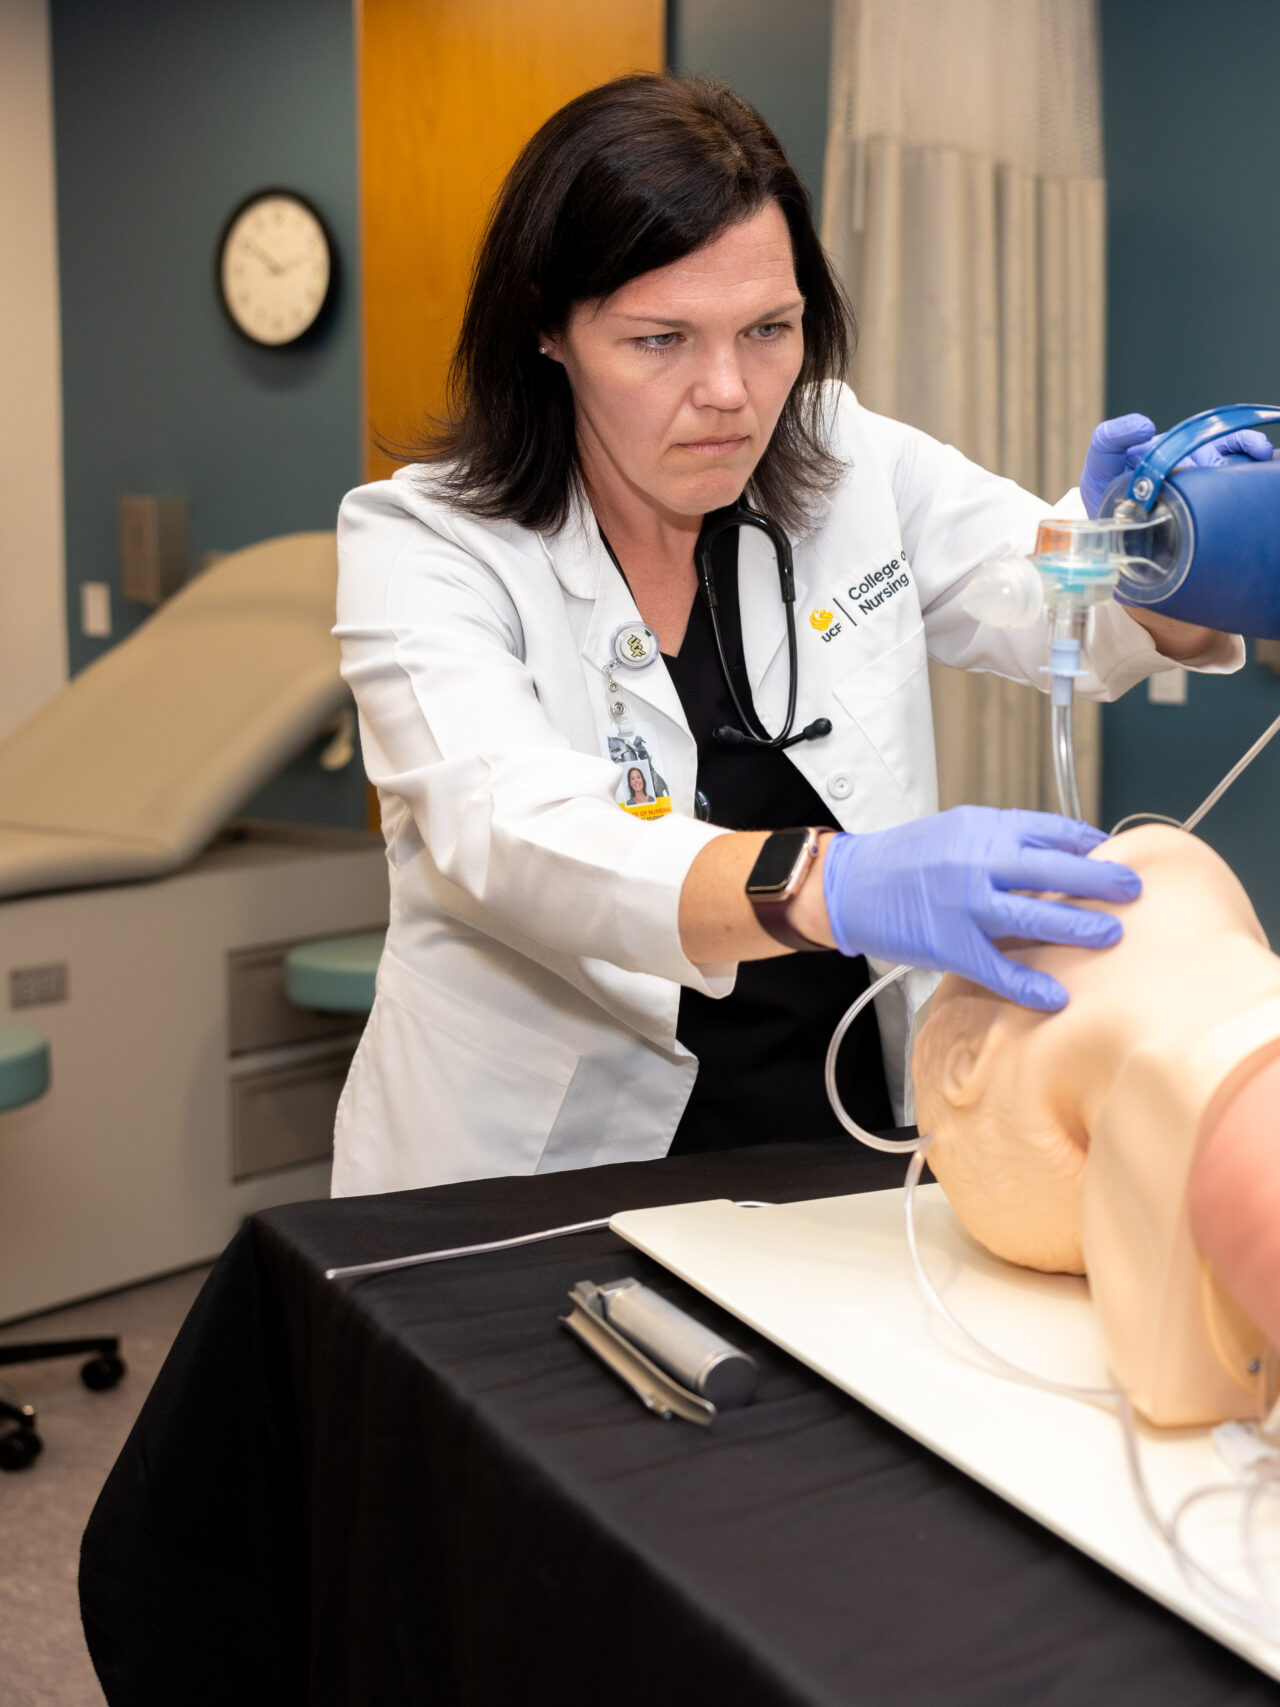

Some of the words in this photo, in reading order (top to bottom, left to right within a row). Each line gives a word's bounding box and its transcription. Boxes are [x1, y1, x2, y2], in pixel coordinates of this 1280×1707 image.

[848, 559, 900, 601] College
[858, 573, 910, 615] Nursing
[821, 623, 843, 643] UCF
